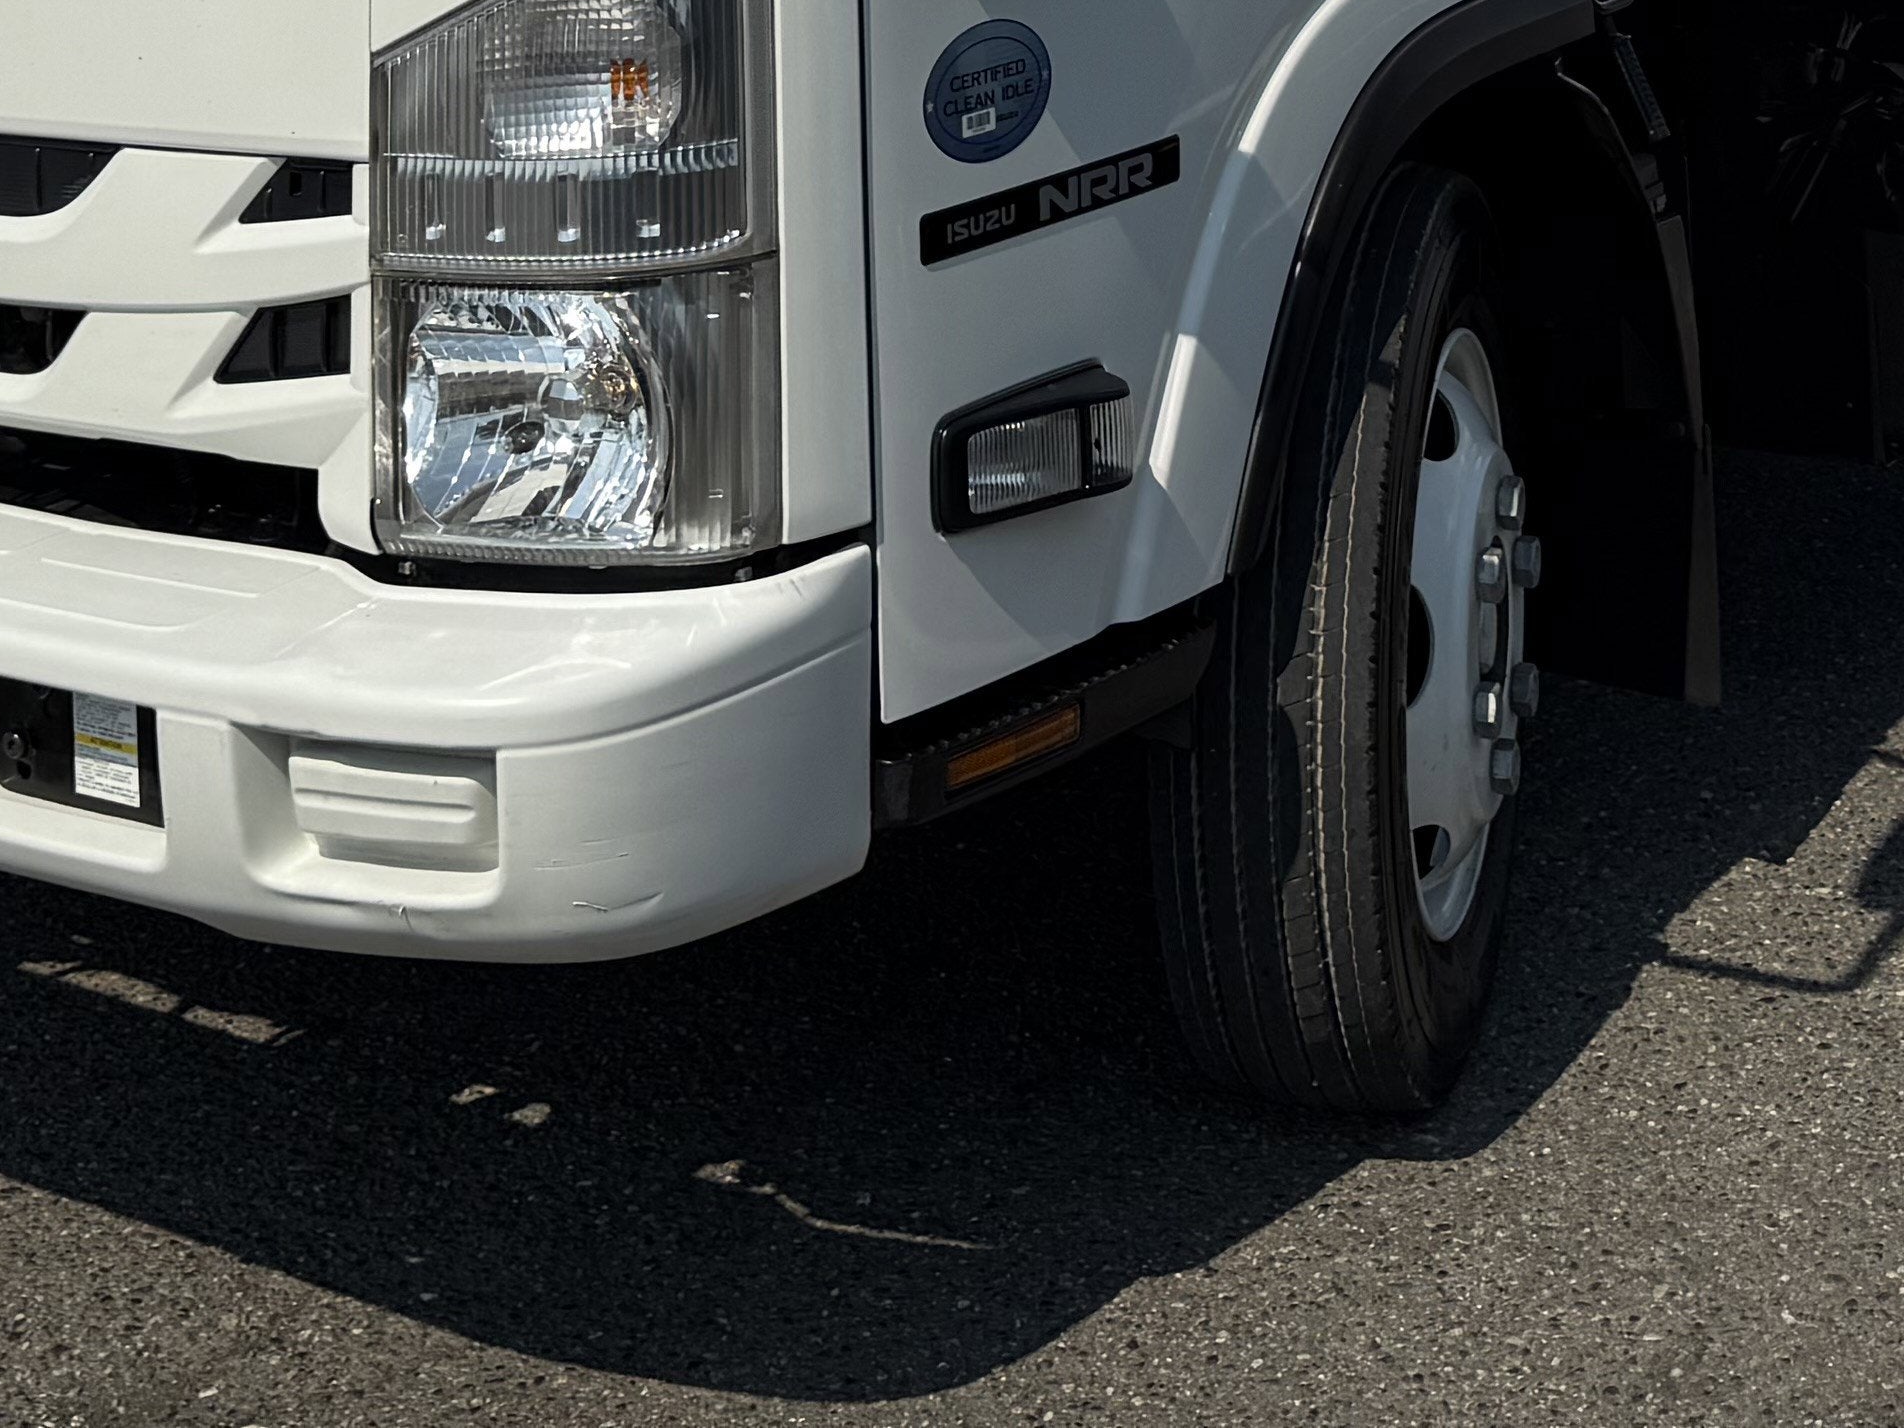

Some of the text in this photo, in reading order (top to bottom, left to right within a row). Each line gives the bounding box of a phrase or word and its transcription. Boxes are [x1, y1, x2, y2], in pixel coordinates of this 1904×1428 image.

[949, 58, 1026, 92] CERTIFIED
[943, 89, 995, 117] CLEAN
[1001, 78, 1034, 101] IDLE
[946, 152, 1153, 244] ISUZU NRR
